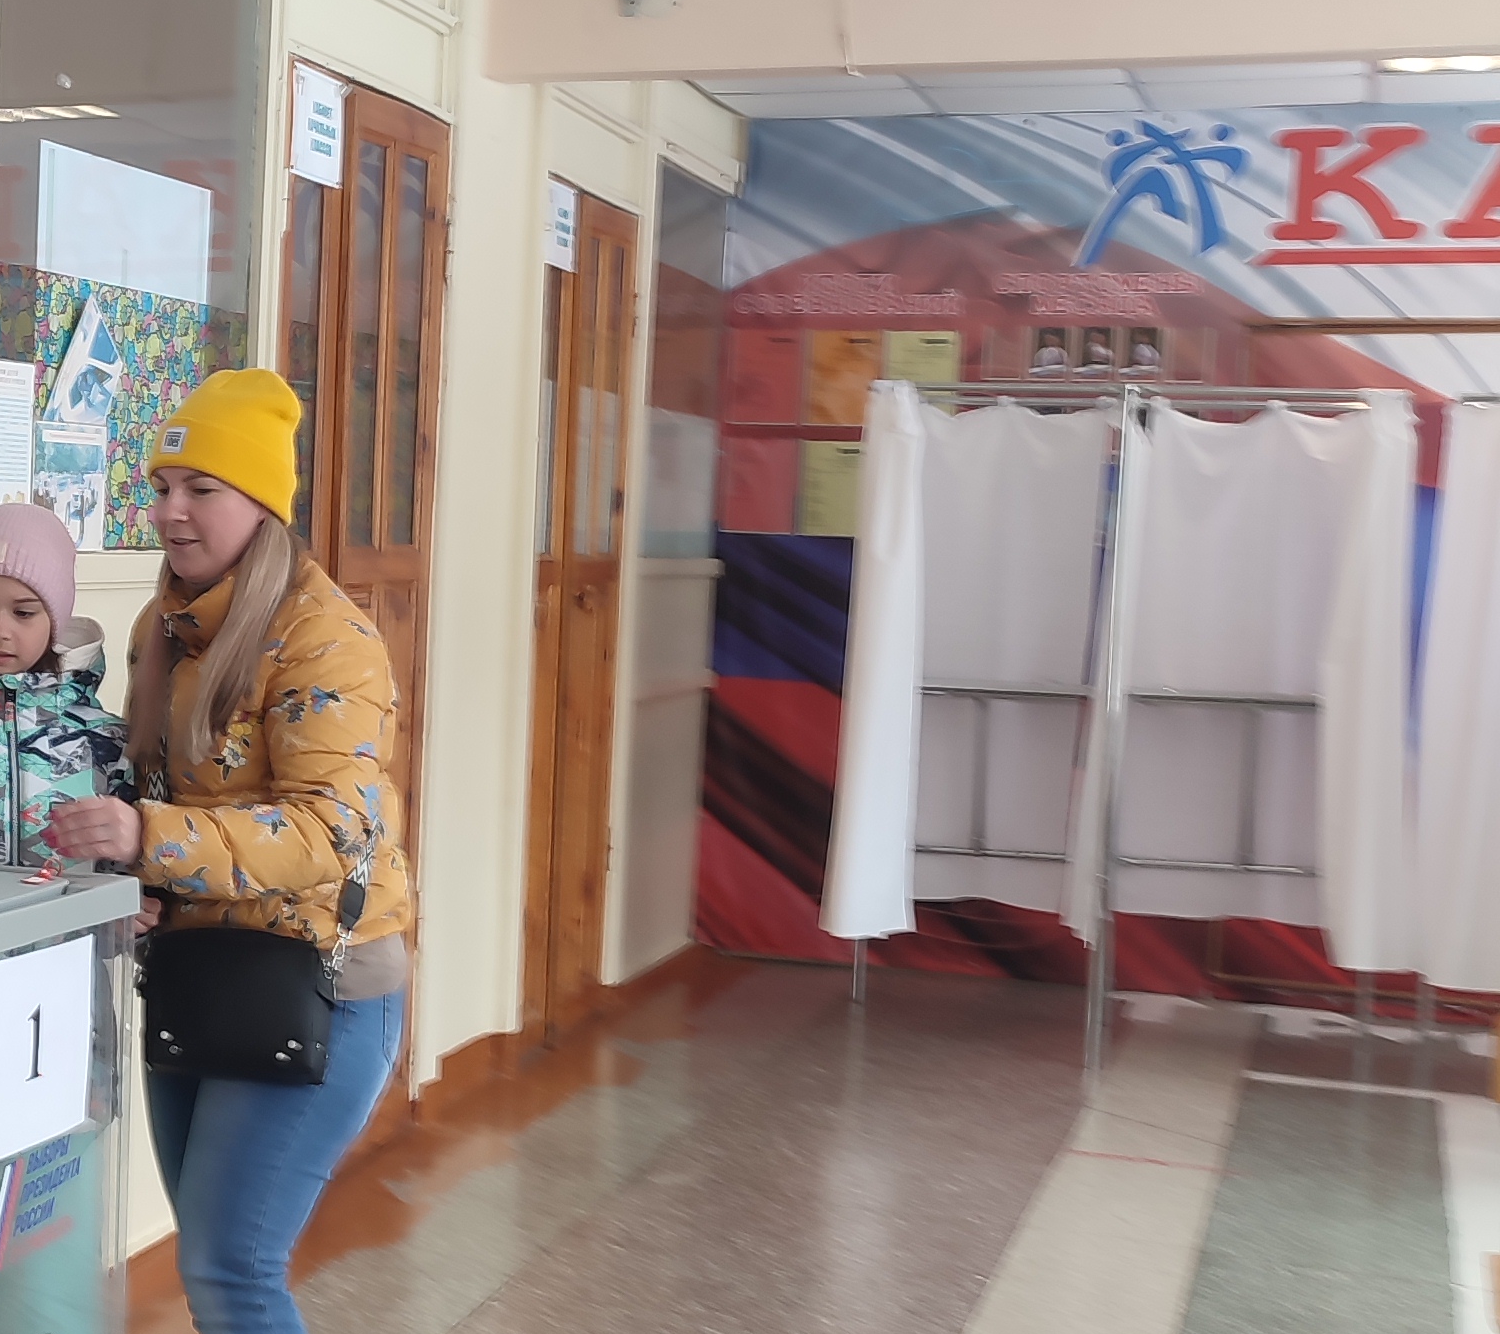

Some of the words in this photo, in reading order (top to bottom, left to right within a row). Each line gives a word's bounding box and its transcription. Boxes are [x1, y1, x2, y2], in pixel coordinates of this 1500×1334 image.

[25, 1003, 42, 1081] 1
[26, 1134, 71, 1175] ВЫБОРЫ
[20, 1155, 81, 1205] ПРЕЗИДЕНТА
[12, 1196, 56, 1237] РОССИИ
